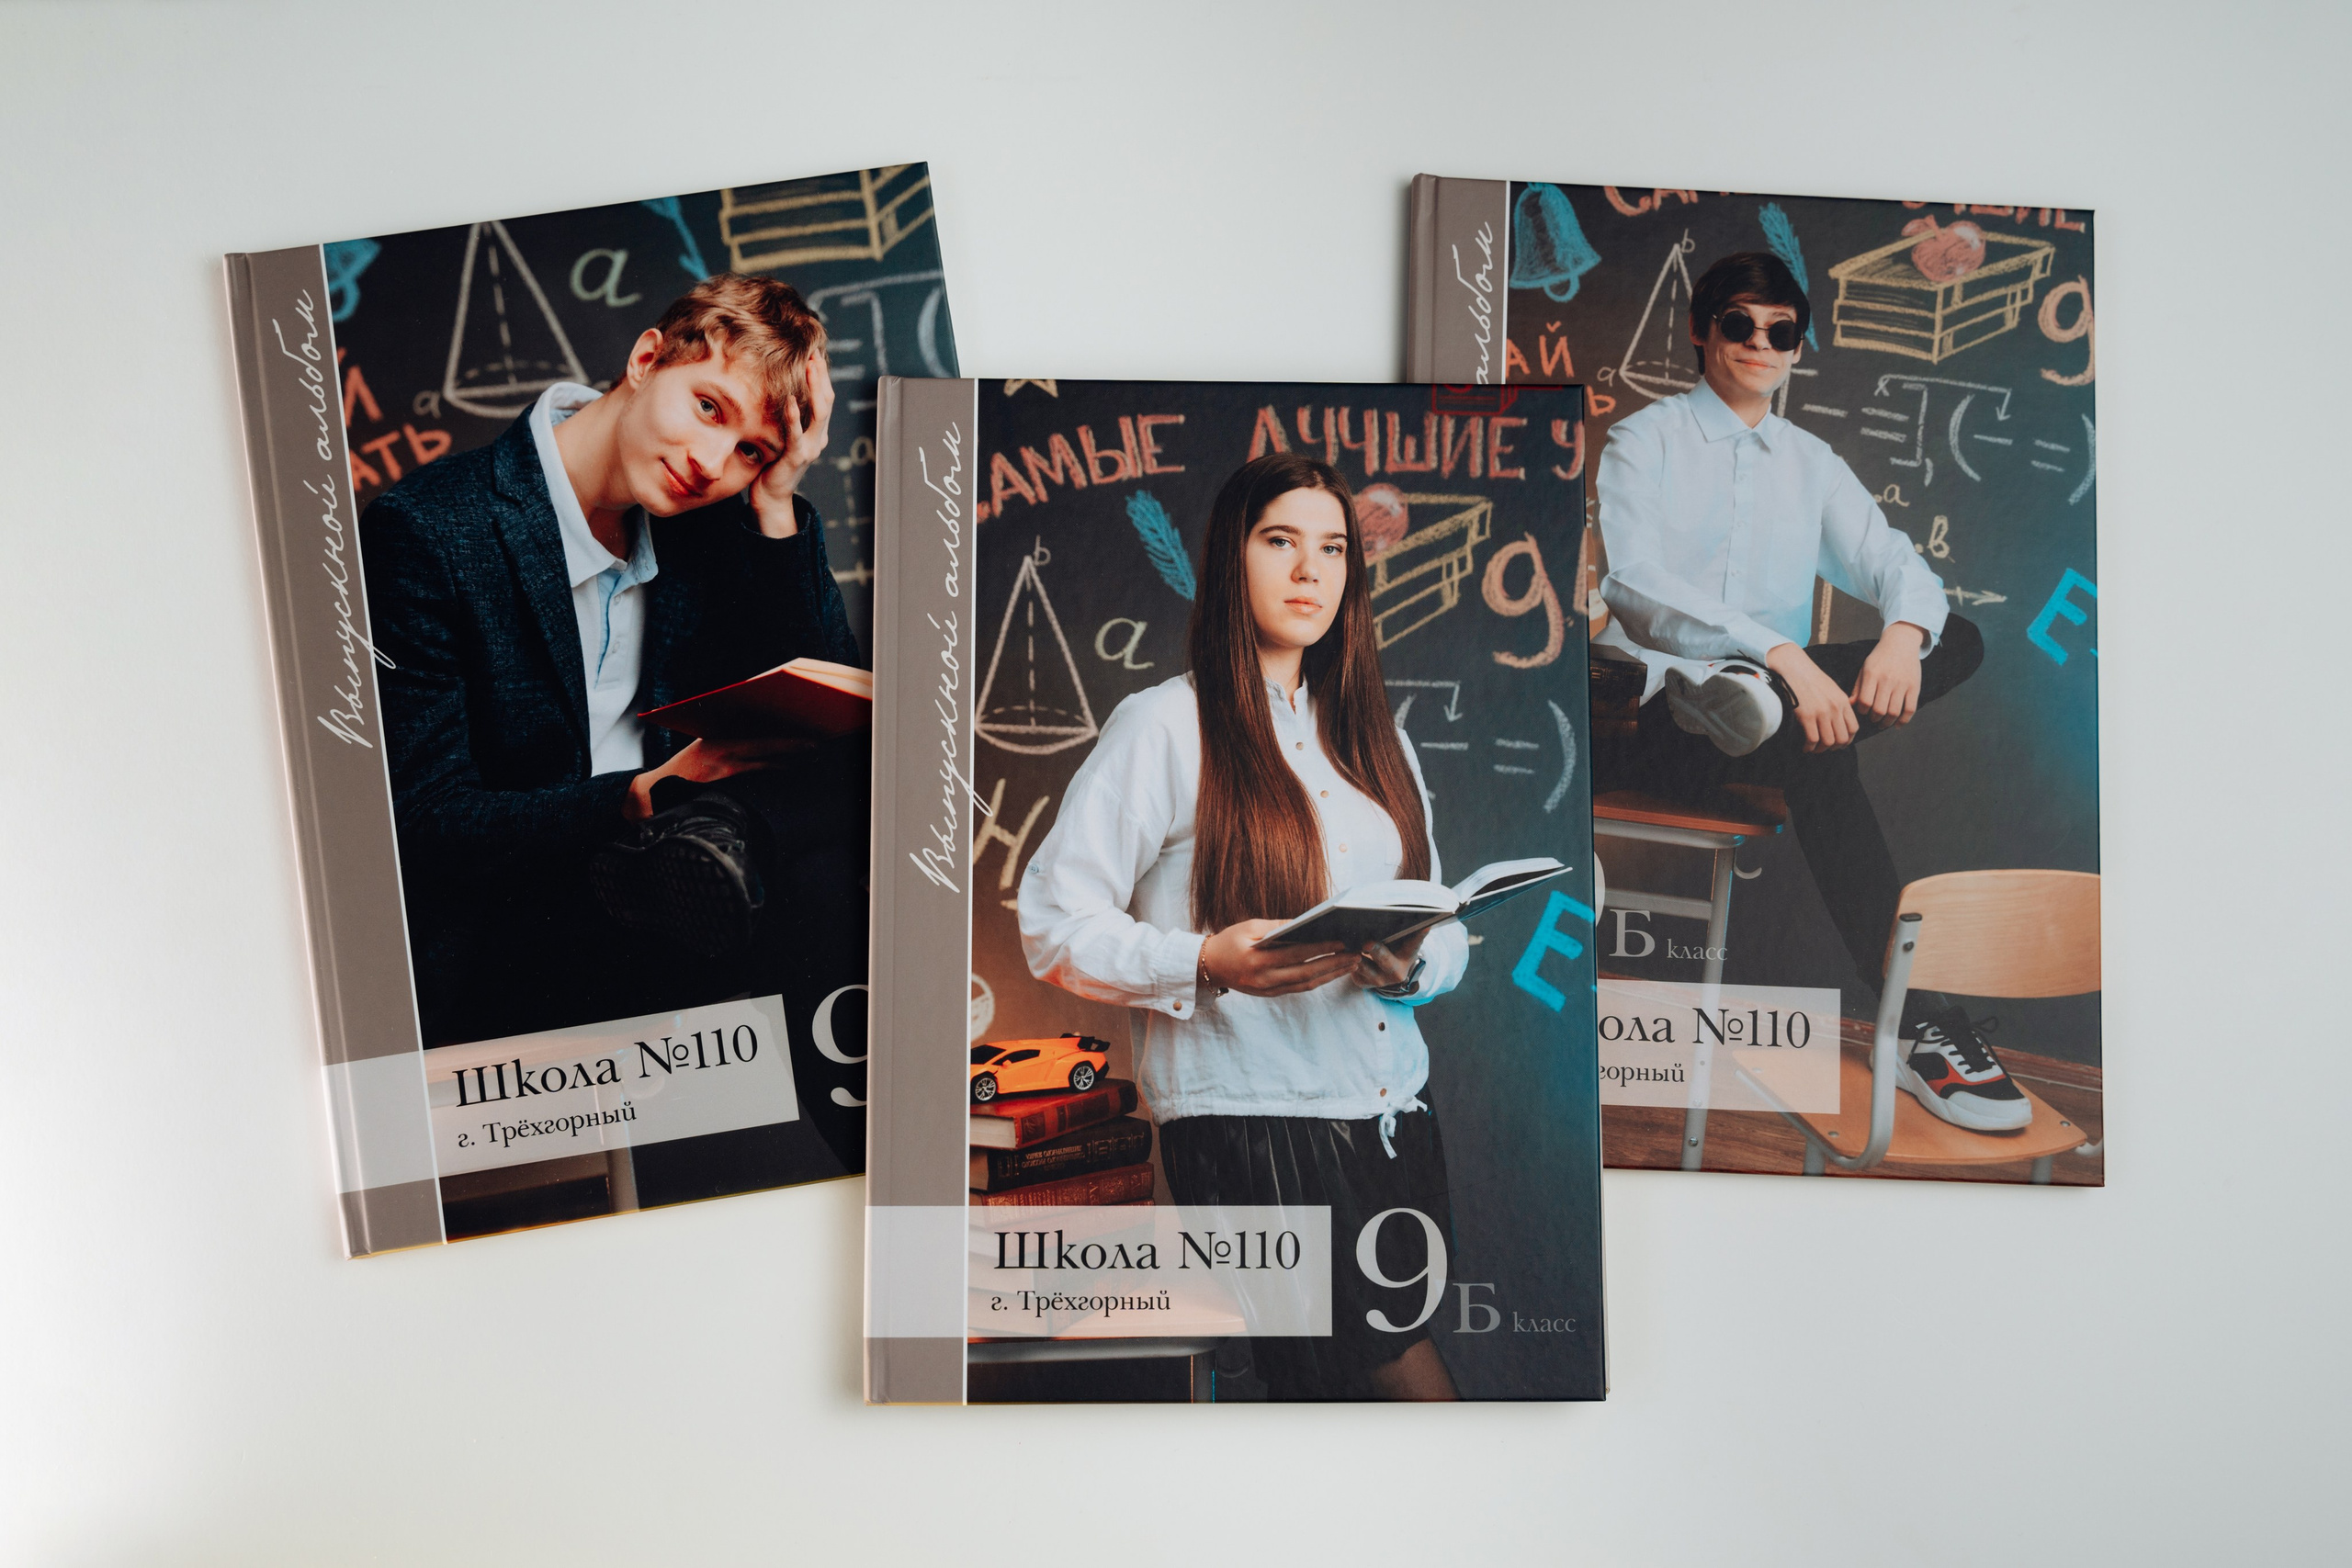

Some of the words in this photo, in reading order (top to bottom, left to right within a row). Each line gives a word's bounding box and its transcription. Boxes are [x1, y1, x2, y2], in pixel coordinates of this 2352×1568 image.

[272, 288, 334, 461] альбом
[977, 414, 1185, 525] АМЫЕ
[1247, 404, 1528, 480] ЛУЧШИЕ
[919, 421, 962, 598] альбом
[303, 474, 396, 749] Выпускной
[910, 613, 993, 893] Выпускной
[1666, 938, 1728, 961] класс
[1598, 1013, 1676, 1043] ола
[1691, 1007, 1811, 1049] №110
[452, 1054, 622, 1108] Школа
[633, 1024, 759, 1079] №110
[457, 1132, 476, 1149] г.
[482, 1100, 638, 1149] Трёхгорный
[993, 1229, 1161, 1270] Школа
[1177, 1229, 1301, 1270] №110
[990, 1295, 1008, 1311] г.
[1017, 1289, 1171, 1318] Трёхгорный
[1512, 1311, 1577, 1333] класс
